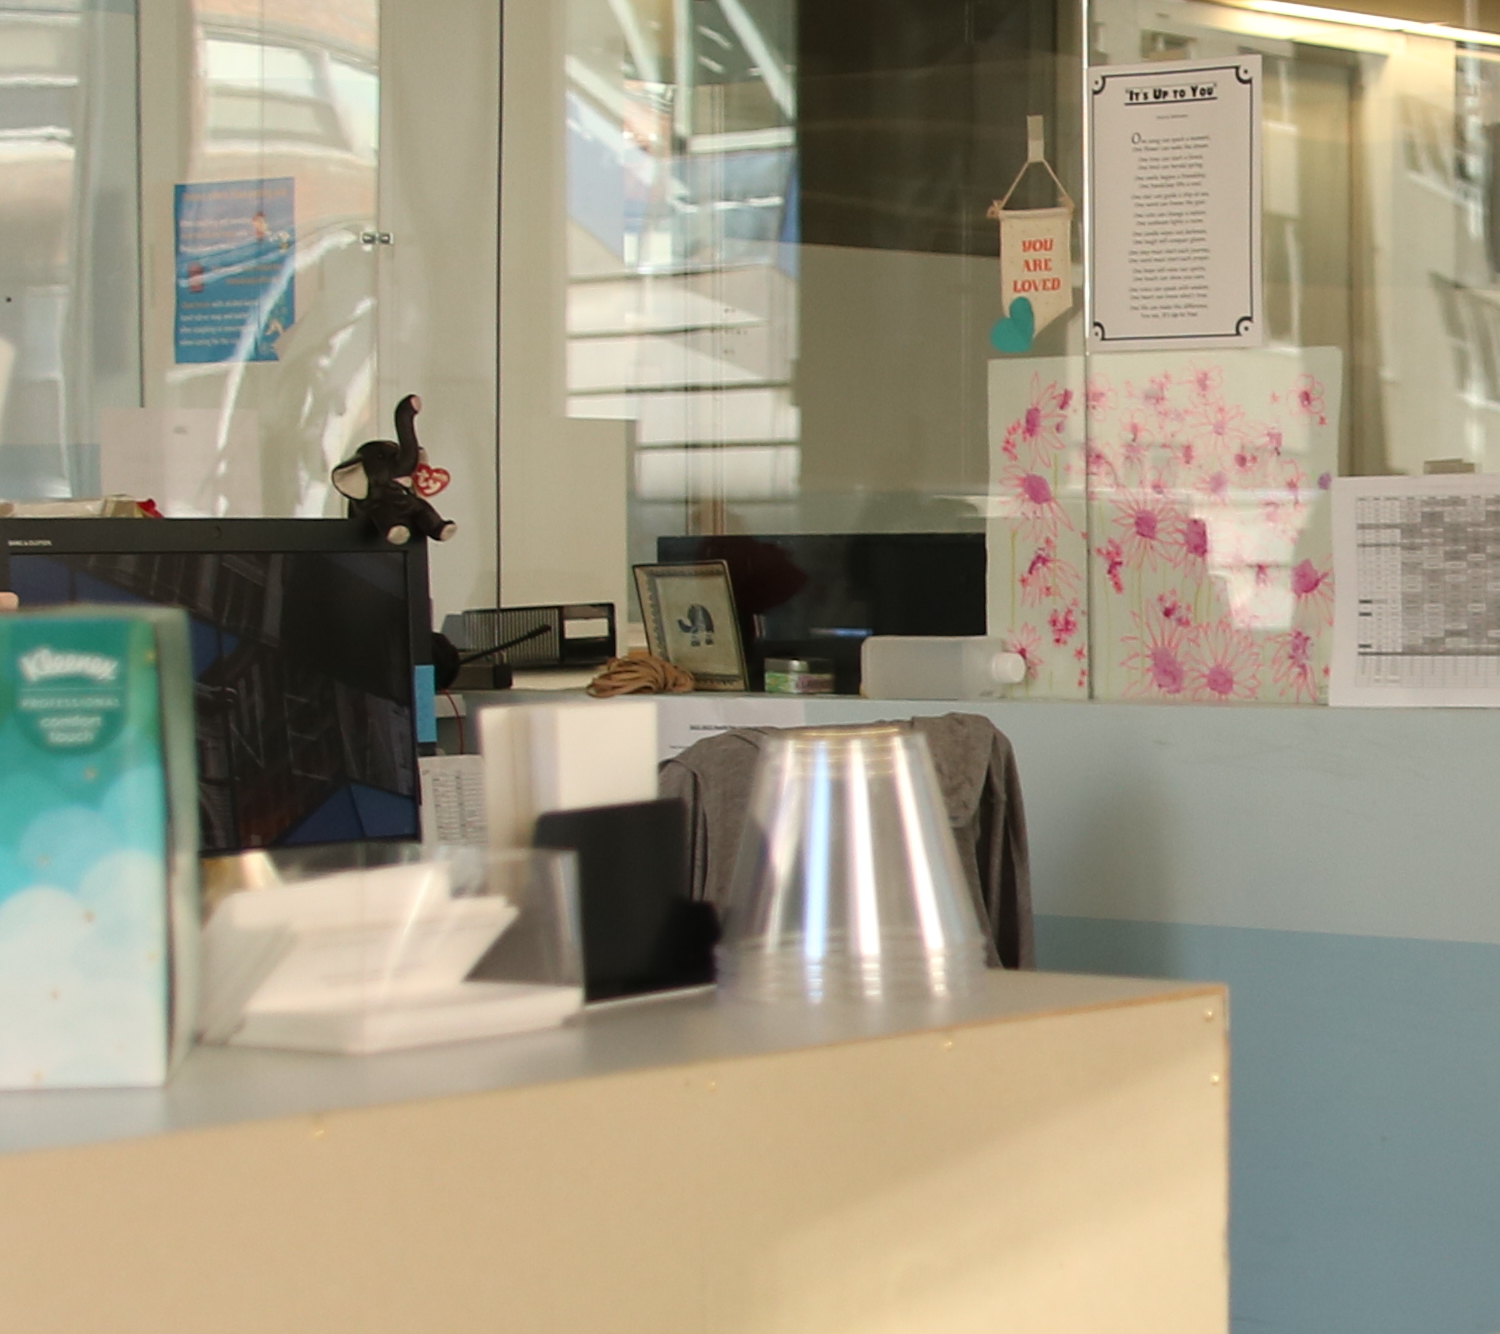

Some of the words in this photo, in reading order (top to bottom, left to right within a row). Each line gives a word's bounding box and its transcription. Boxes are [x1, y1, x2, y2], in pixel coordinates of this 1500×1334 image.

[1022, 238, 1054, 252] YOU
[1024, 258, 1052, 272] ARE
[1013, 277, 1061, 293] LOVED
